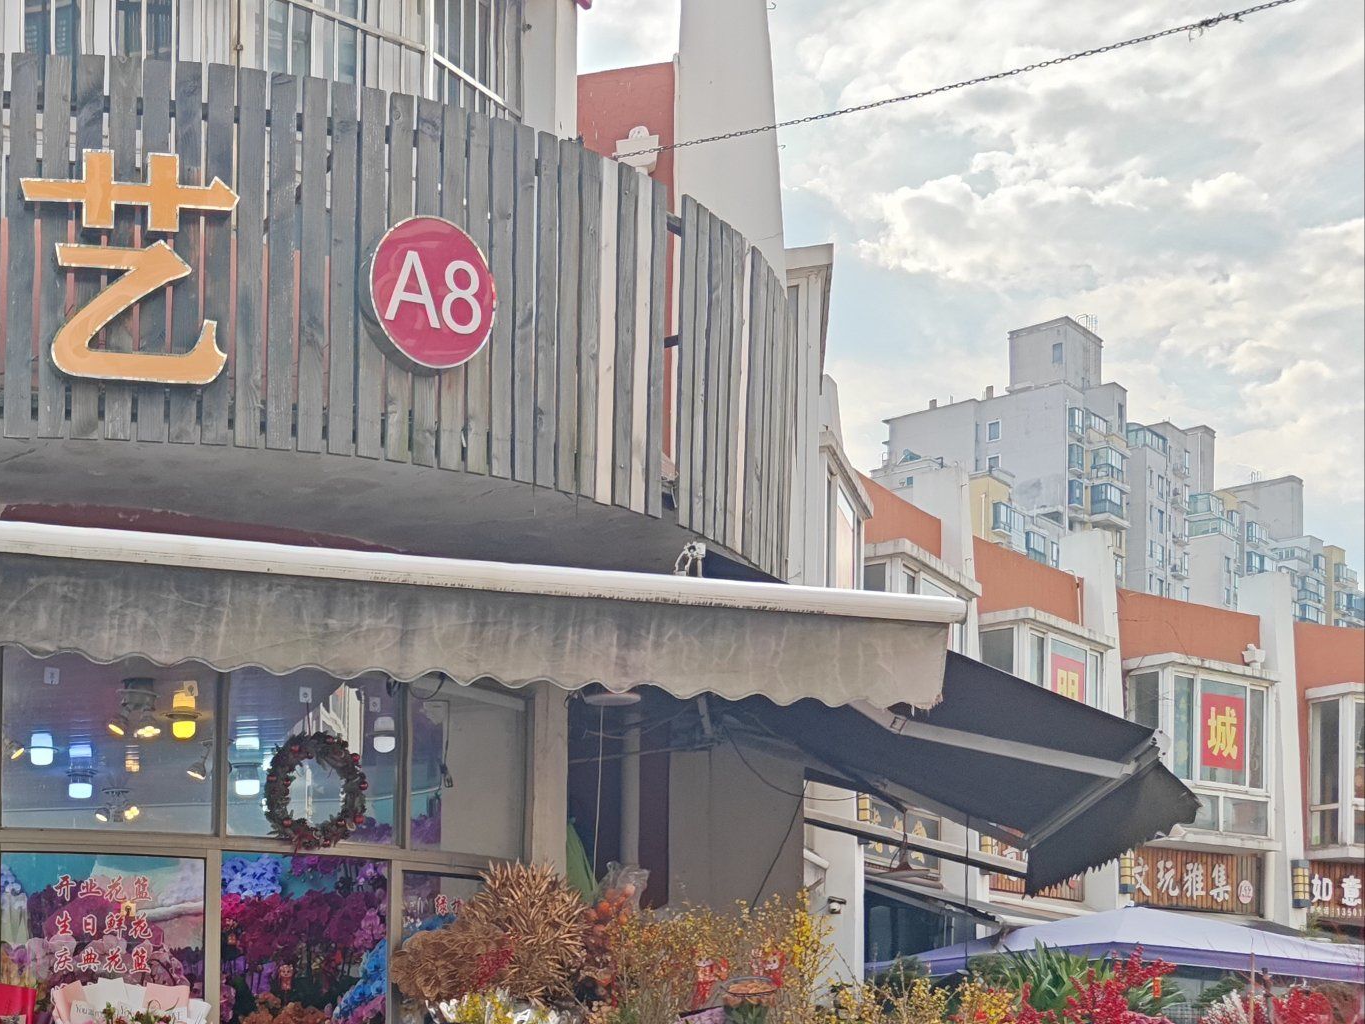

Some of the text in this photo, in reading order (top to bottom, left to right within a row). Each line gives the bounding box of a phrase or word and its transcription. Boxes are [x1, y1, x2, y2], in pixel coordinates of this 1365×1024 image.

[384, 249, 482, 336] A8
[1207, 706, 1238, 760] 城
[53, 874, 152, 901] 开业花篮
[1133, 857, 1231, 903] 文玩雅集
[1311, 873, 1362, 907] 如意
[55, 910, 152, 939] 生日鲜花
[54, 946, 151, 974] 庆典花篮
